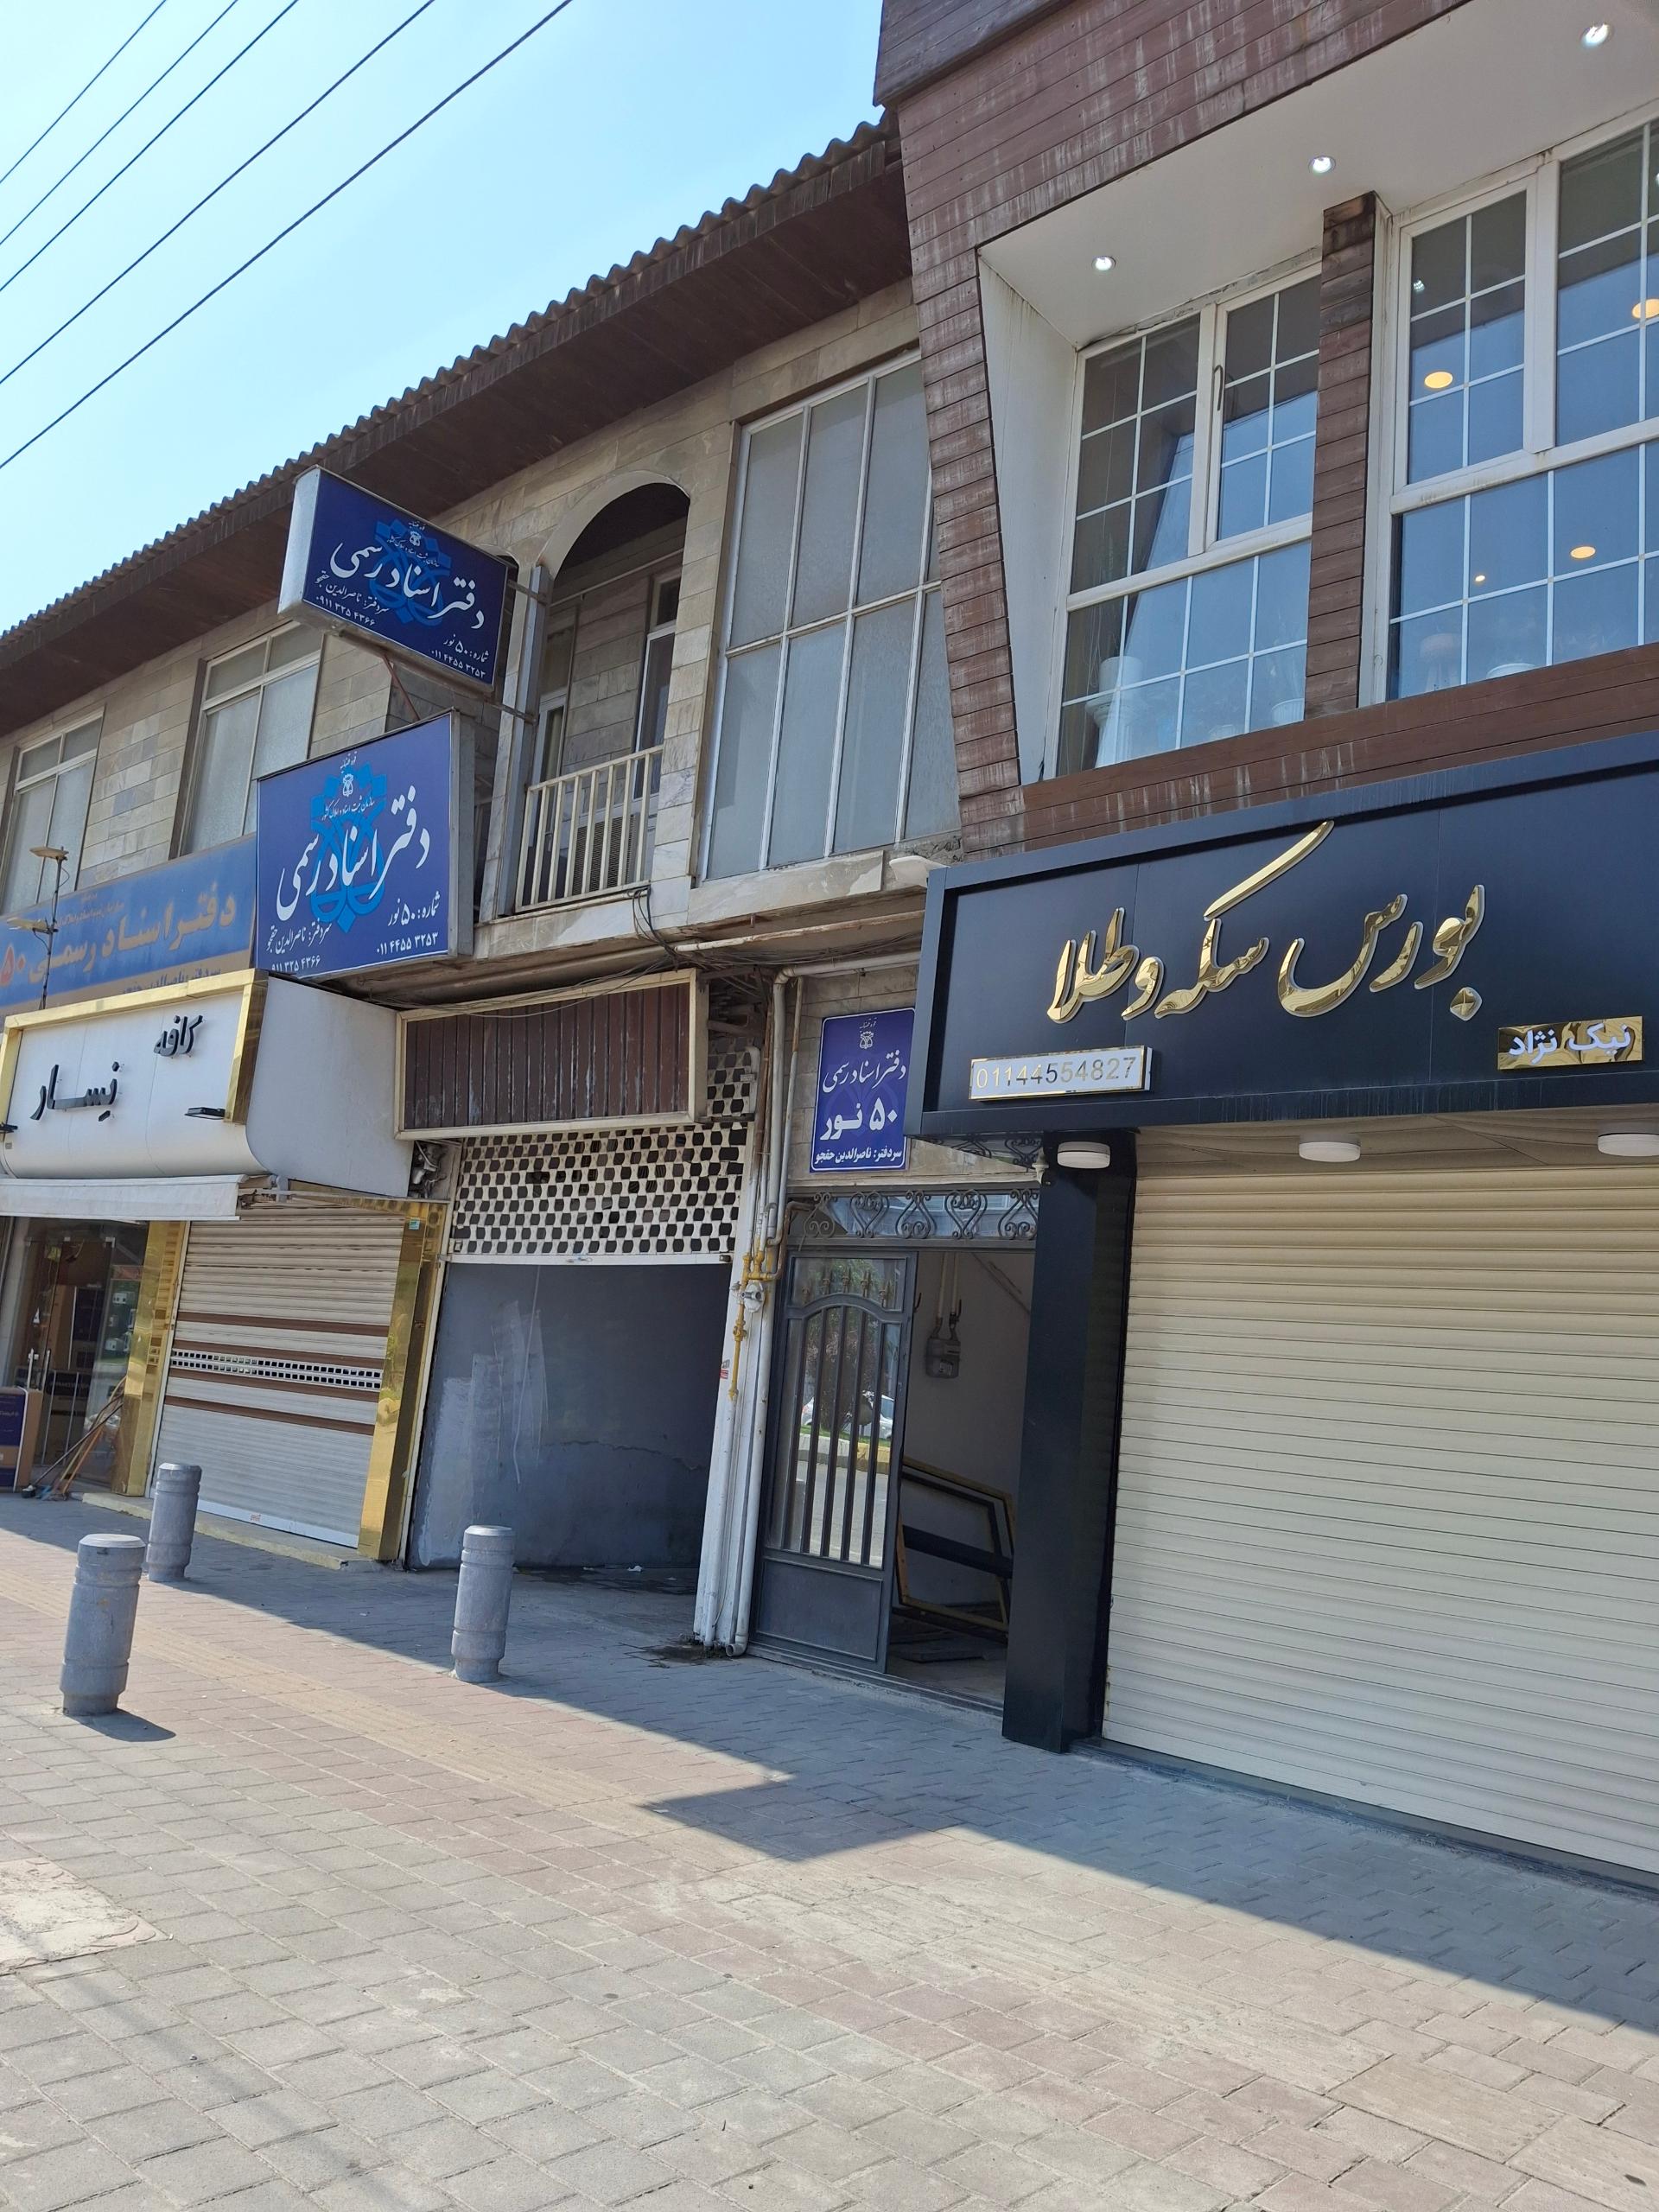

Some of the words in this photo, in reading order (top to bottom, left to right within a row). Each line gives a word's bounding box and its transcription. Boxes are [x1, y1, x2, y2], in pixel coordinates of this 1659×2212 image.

[330, 543, 383, 578] رسمی
[385, 563, 440, 607] اسناد
[427, 576, 485, 629] دفتر
[363, 596, 390, 614] سردفتر:
[443, 633, 456, 646] نور
[455, 640, 467, 654] ۵۰
[469, 650, 489, 663] شماره:
[326, 825, 378, 891] اسناد
[369, 785, 429, 899] دفتر
[276, 833, 321, 921] رسمی
[171, 882, 237, 950] دفتر
[388, 898, 400, 926] نور
[401, 903, 415, 925] ۵۰
[417, 891, 440, 918] شماره:
[1154, 820, 1334, 1019] سکه
[101, 902, 173, 957] اسناد
[308, 918, 332, 947] سردفتر:
[390, 938, 412, 953] ۴۴۵۵
[28, 940, 96, 983] رسمی
[1046, 906, 1140, 1023] طلا
[1277, 884, 1485, 1022] بورس
[1122, 956, 1163, 1020] و
[154, 1014, 203, 1058] کافه
[1509, 1029, 1558, 1065] نژاد
[1568, 1023, 1631, 1055] نیک
[823, 1060, 849, 1093] رسمی
[850, 1060, 880, 1084] اسناد
[871, 1049, 906, 1090] دفتر
[976, 1056, 1136, 1089] 01144554827
[820, 1103, 863, 1141] نور
[869, 1096, 898, 1131] ۵۰
[835, 1147, 872, 1164] ناصرالدین
[874, 1145, 902, 1162] سردفتر:
